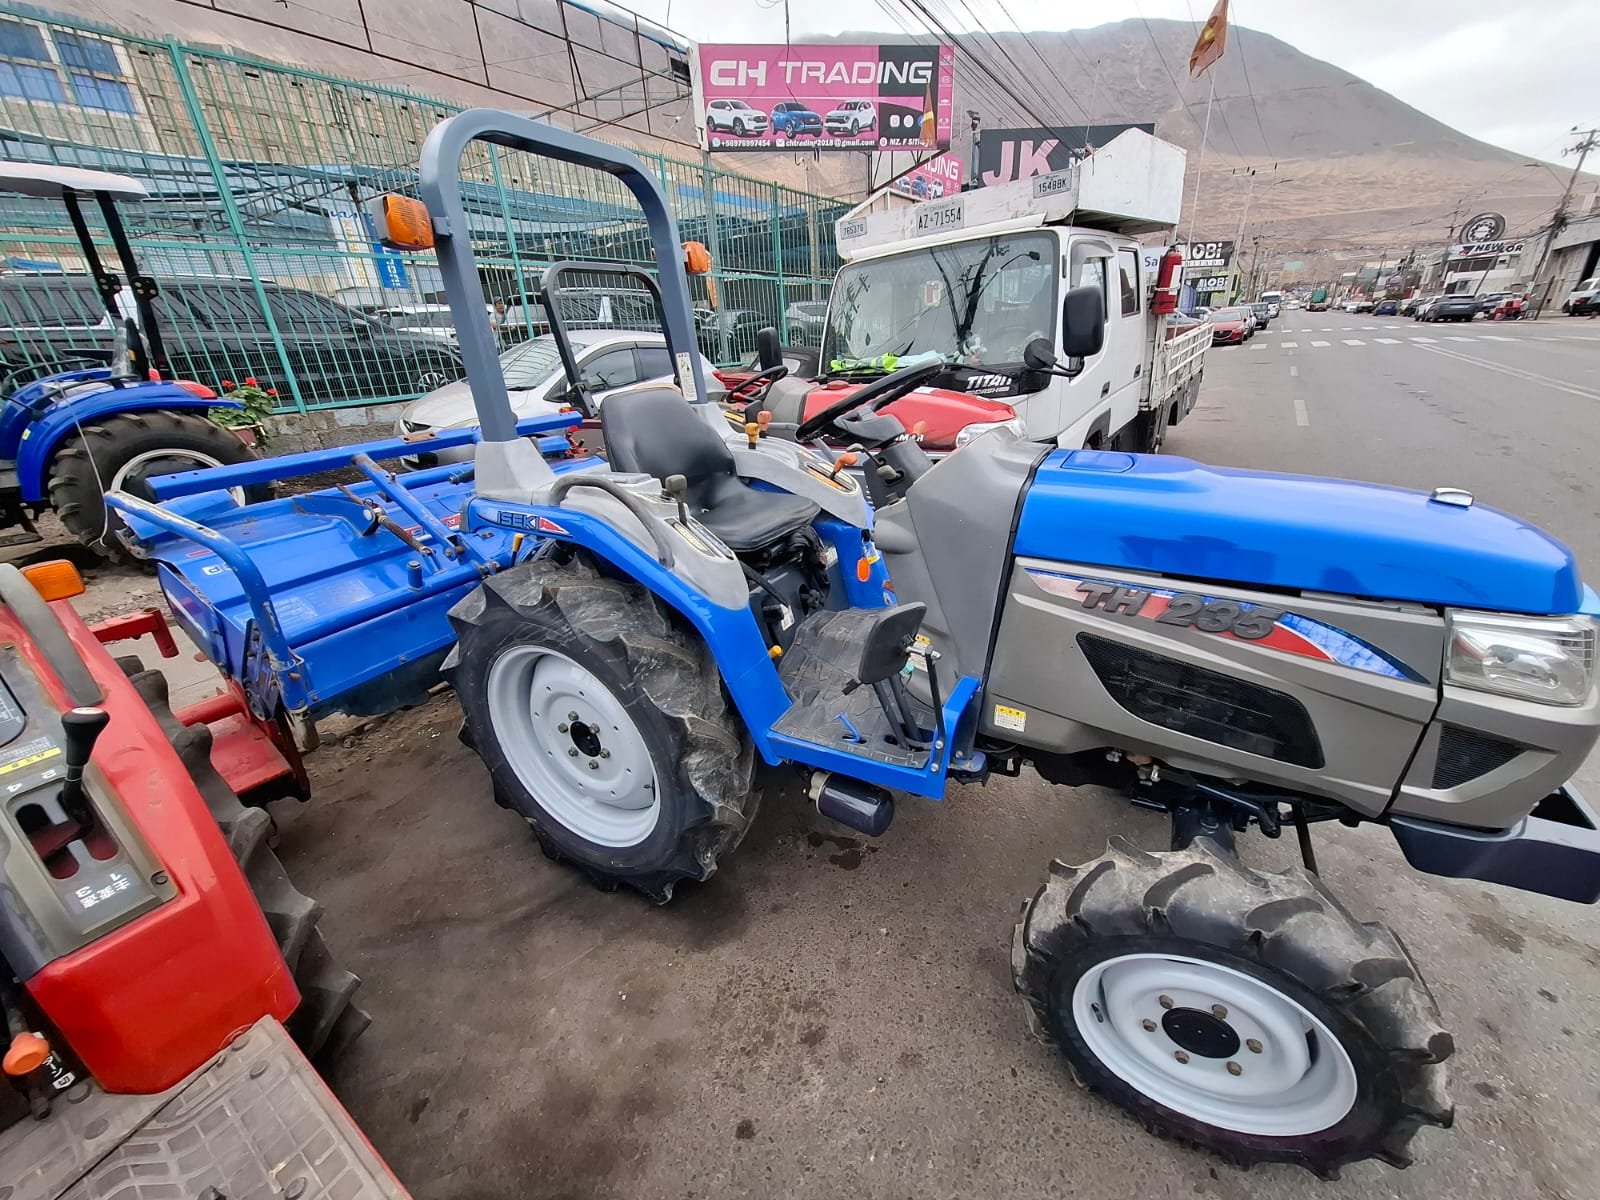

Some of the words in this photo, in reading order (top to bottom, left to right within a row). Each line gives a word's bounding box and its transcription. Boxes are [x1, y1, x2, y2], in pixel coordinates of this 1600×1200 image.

[710, 60, 767, 87] CH
[778, 60, 933, 85] TRADING
[982, 139, 1059, 187] JK
[496, 510, 540, 530] ISEKI
[1075, 580, 1151, 617] TH
[1154, 593, 1286, 640] 235
